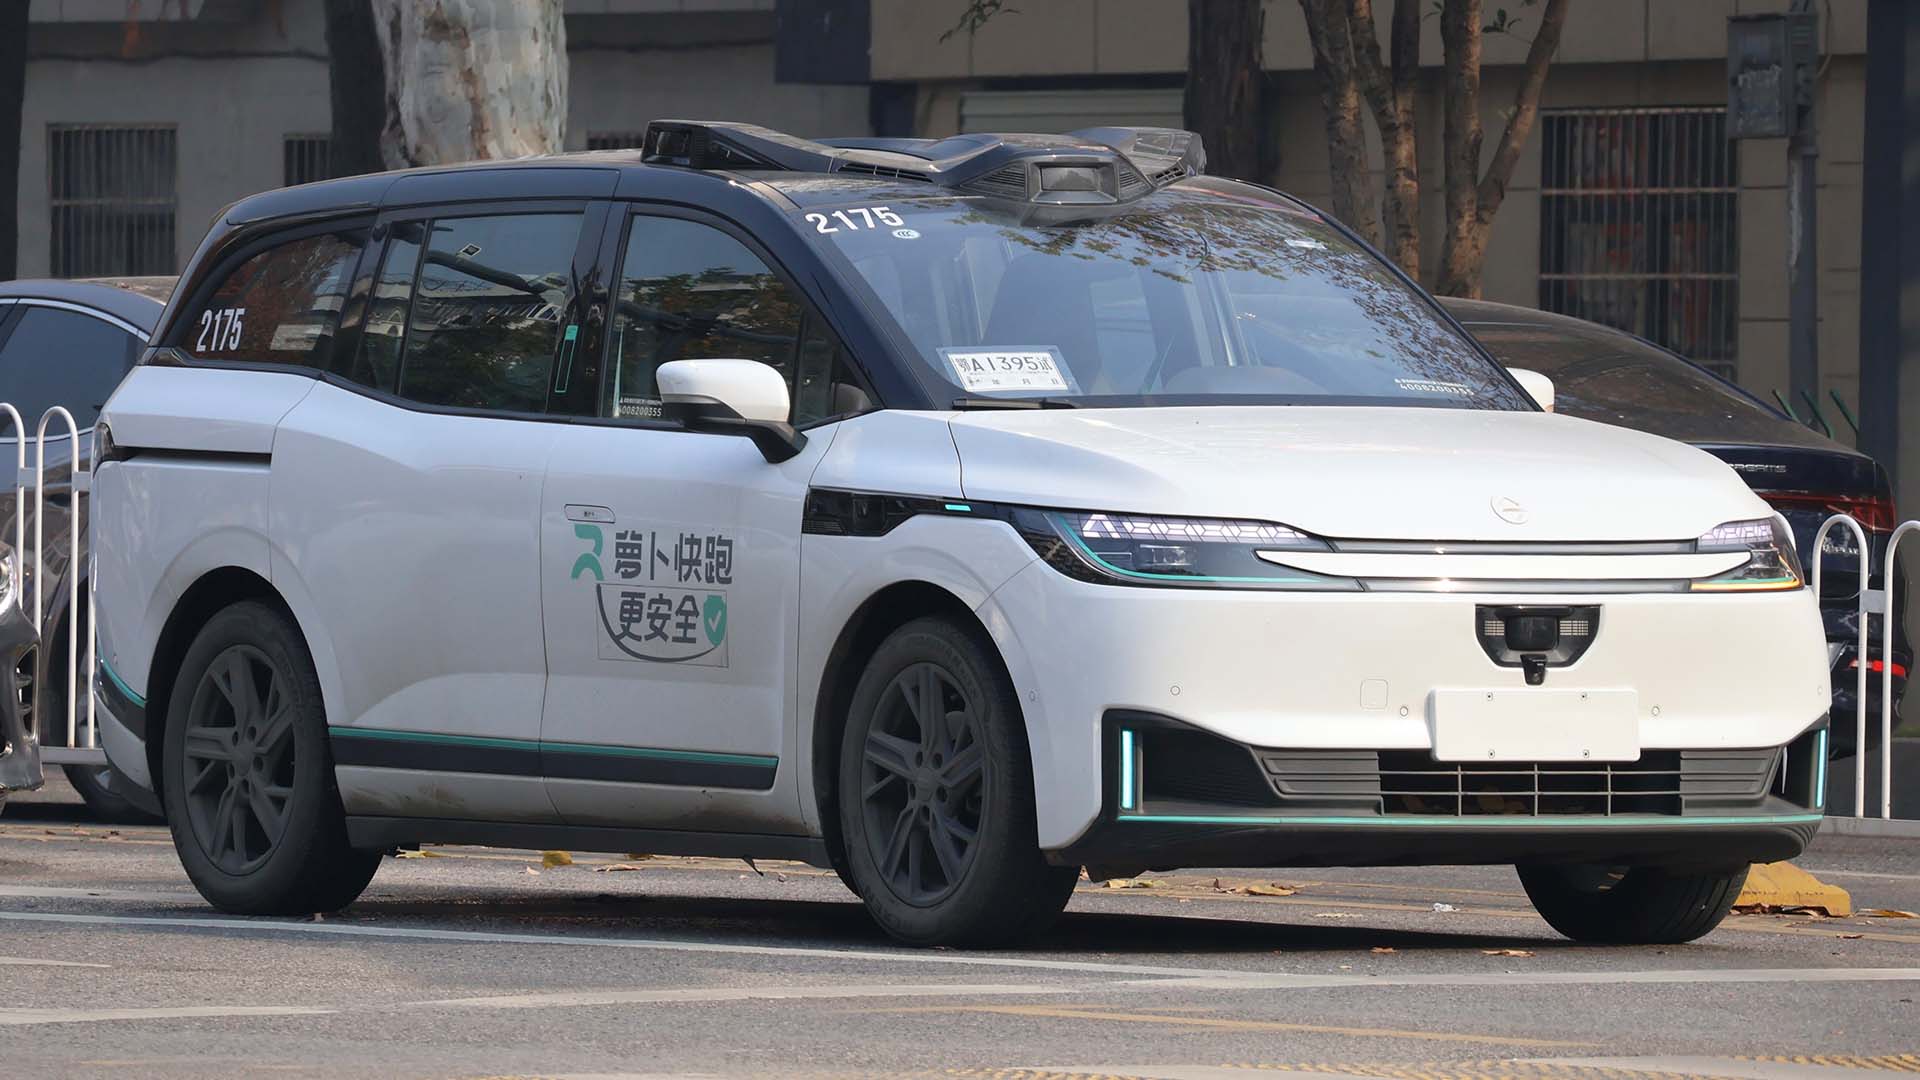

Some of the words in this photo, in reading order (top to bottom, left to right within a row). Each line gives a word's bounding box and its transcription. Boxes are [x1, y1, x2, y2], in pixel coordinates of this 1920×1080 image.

[805, 206, 904, 234] 2175
[196, 308, 245, 352] 2175
[615, 530, 733, 584] 萝卜快跑
[615, 591, 700, 644] 更安全
